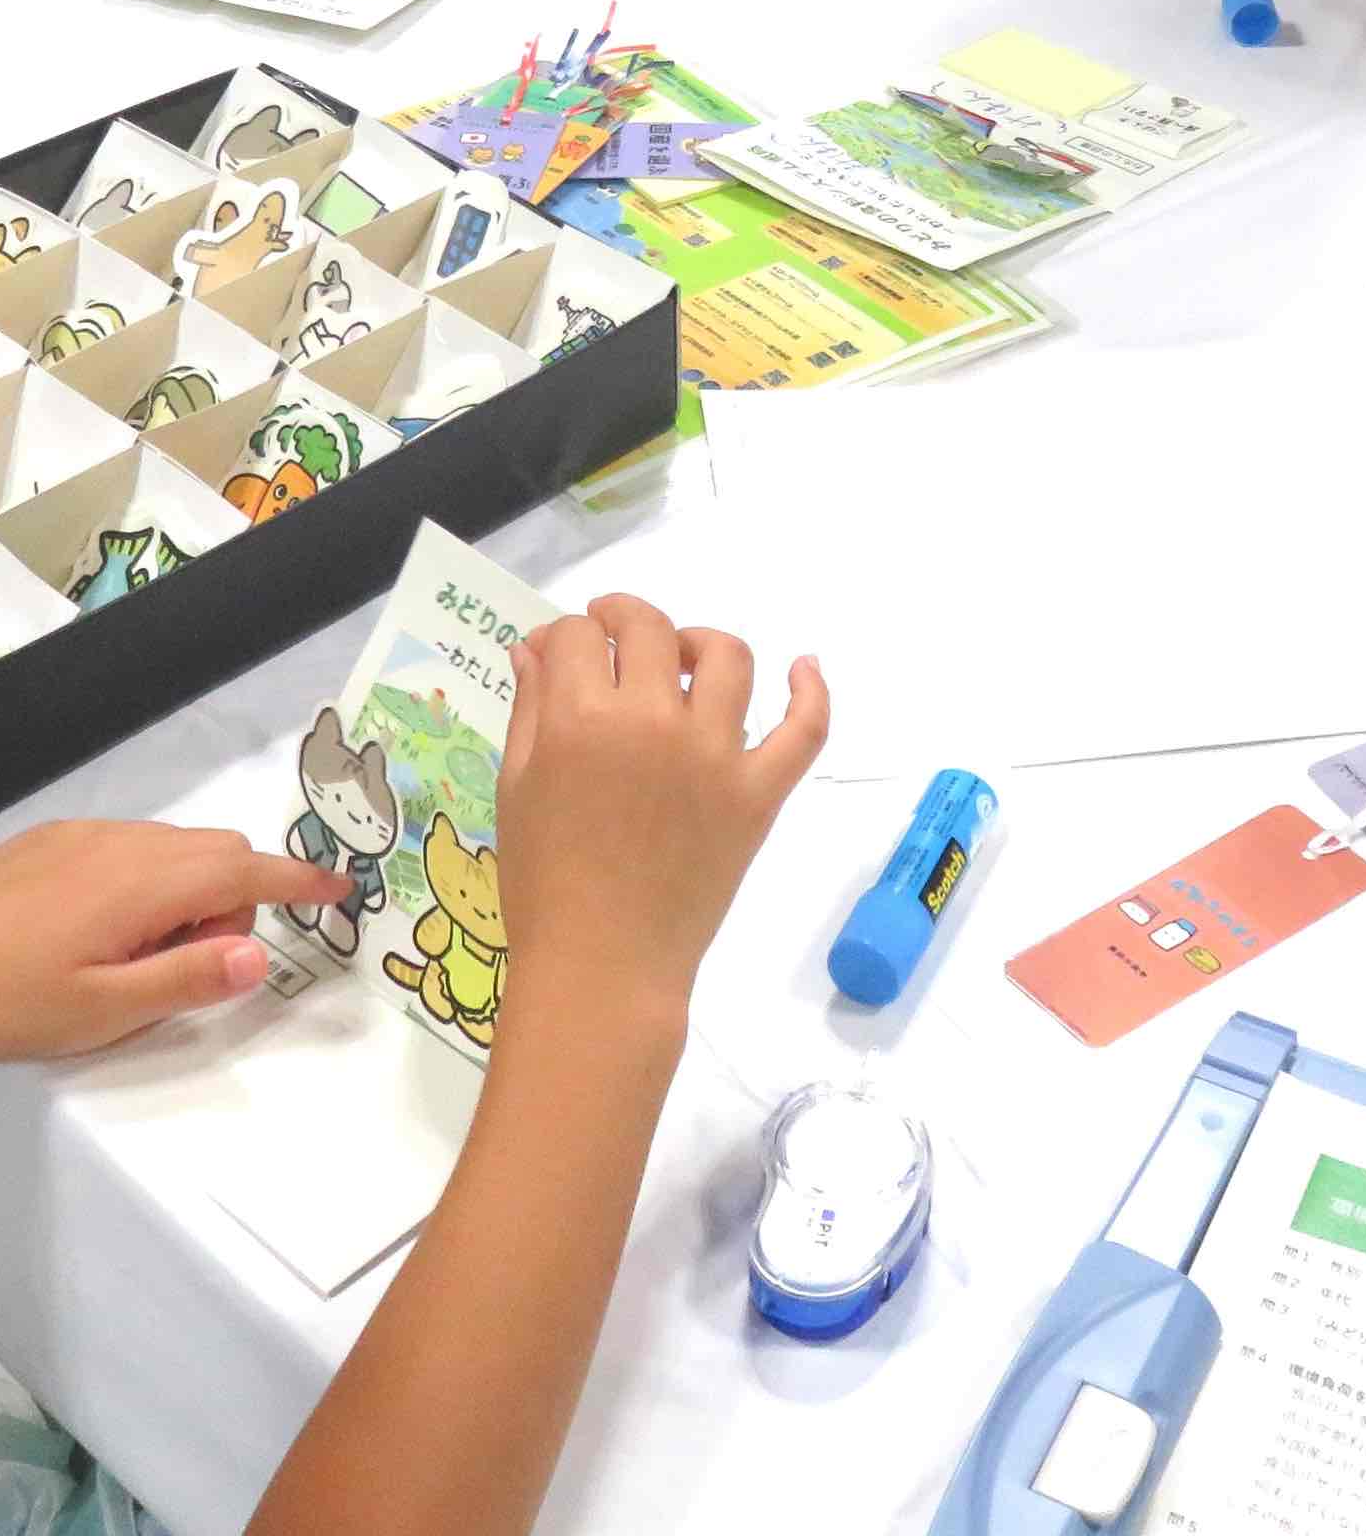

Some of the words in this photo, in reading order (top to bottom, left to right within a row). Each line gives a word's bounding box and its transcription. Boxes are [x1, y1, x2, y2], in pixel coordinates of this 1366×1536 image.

[435, 581, 527, 652] みどりの
[926, 849, 968, 914] Scotch
